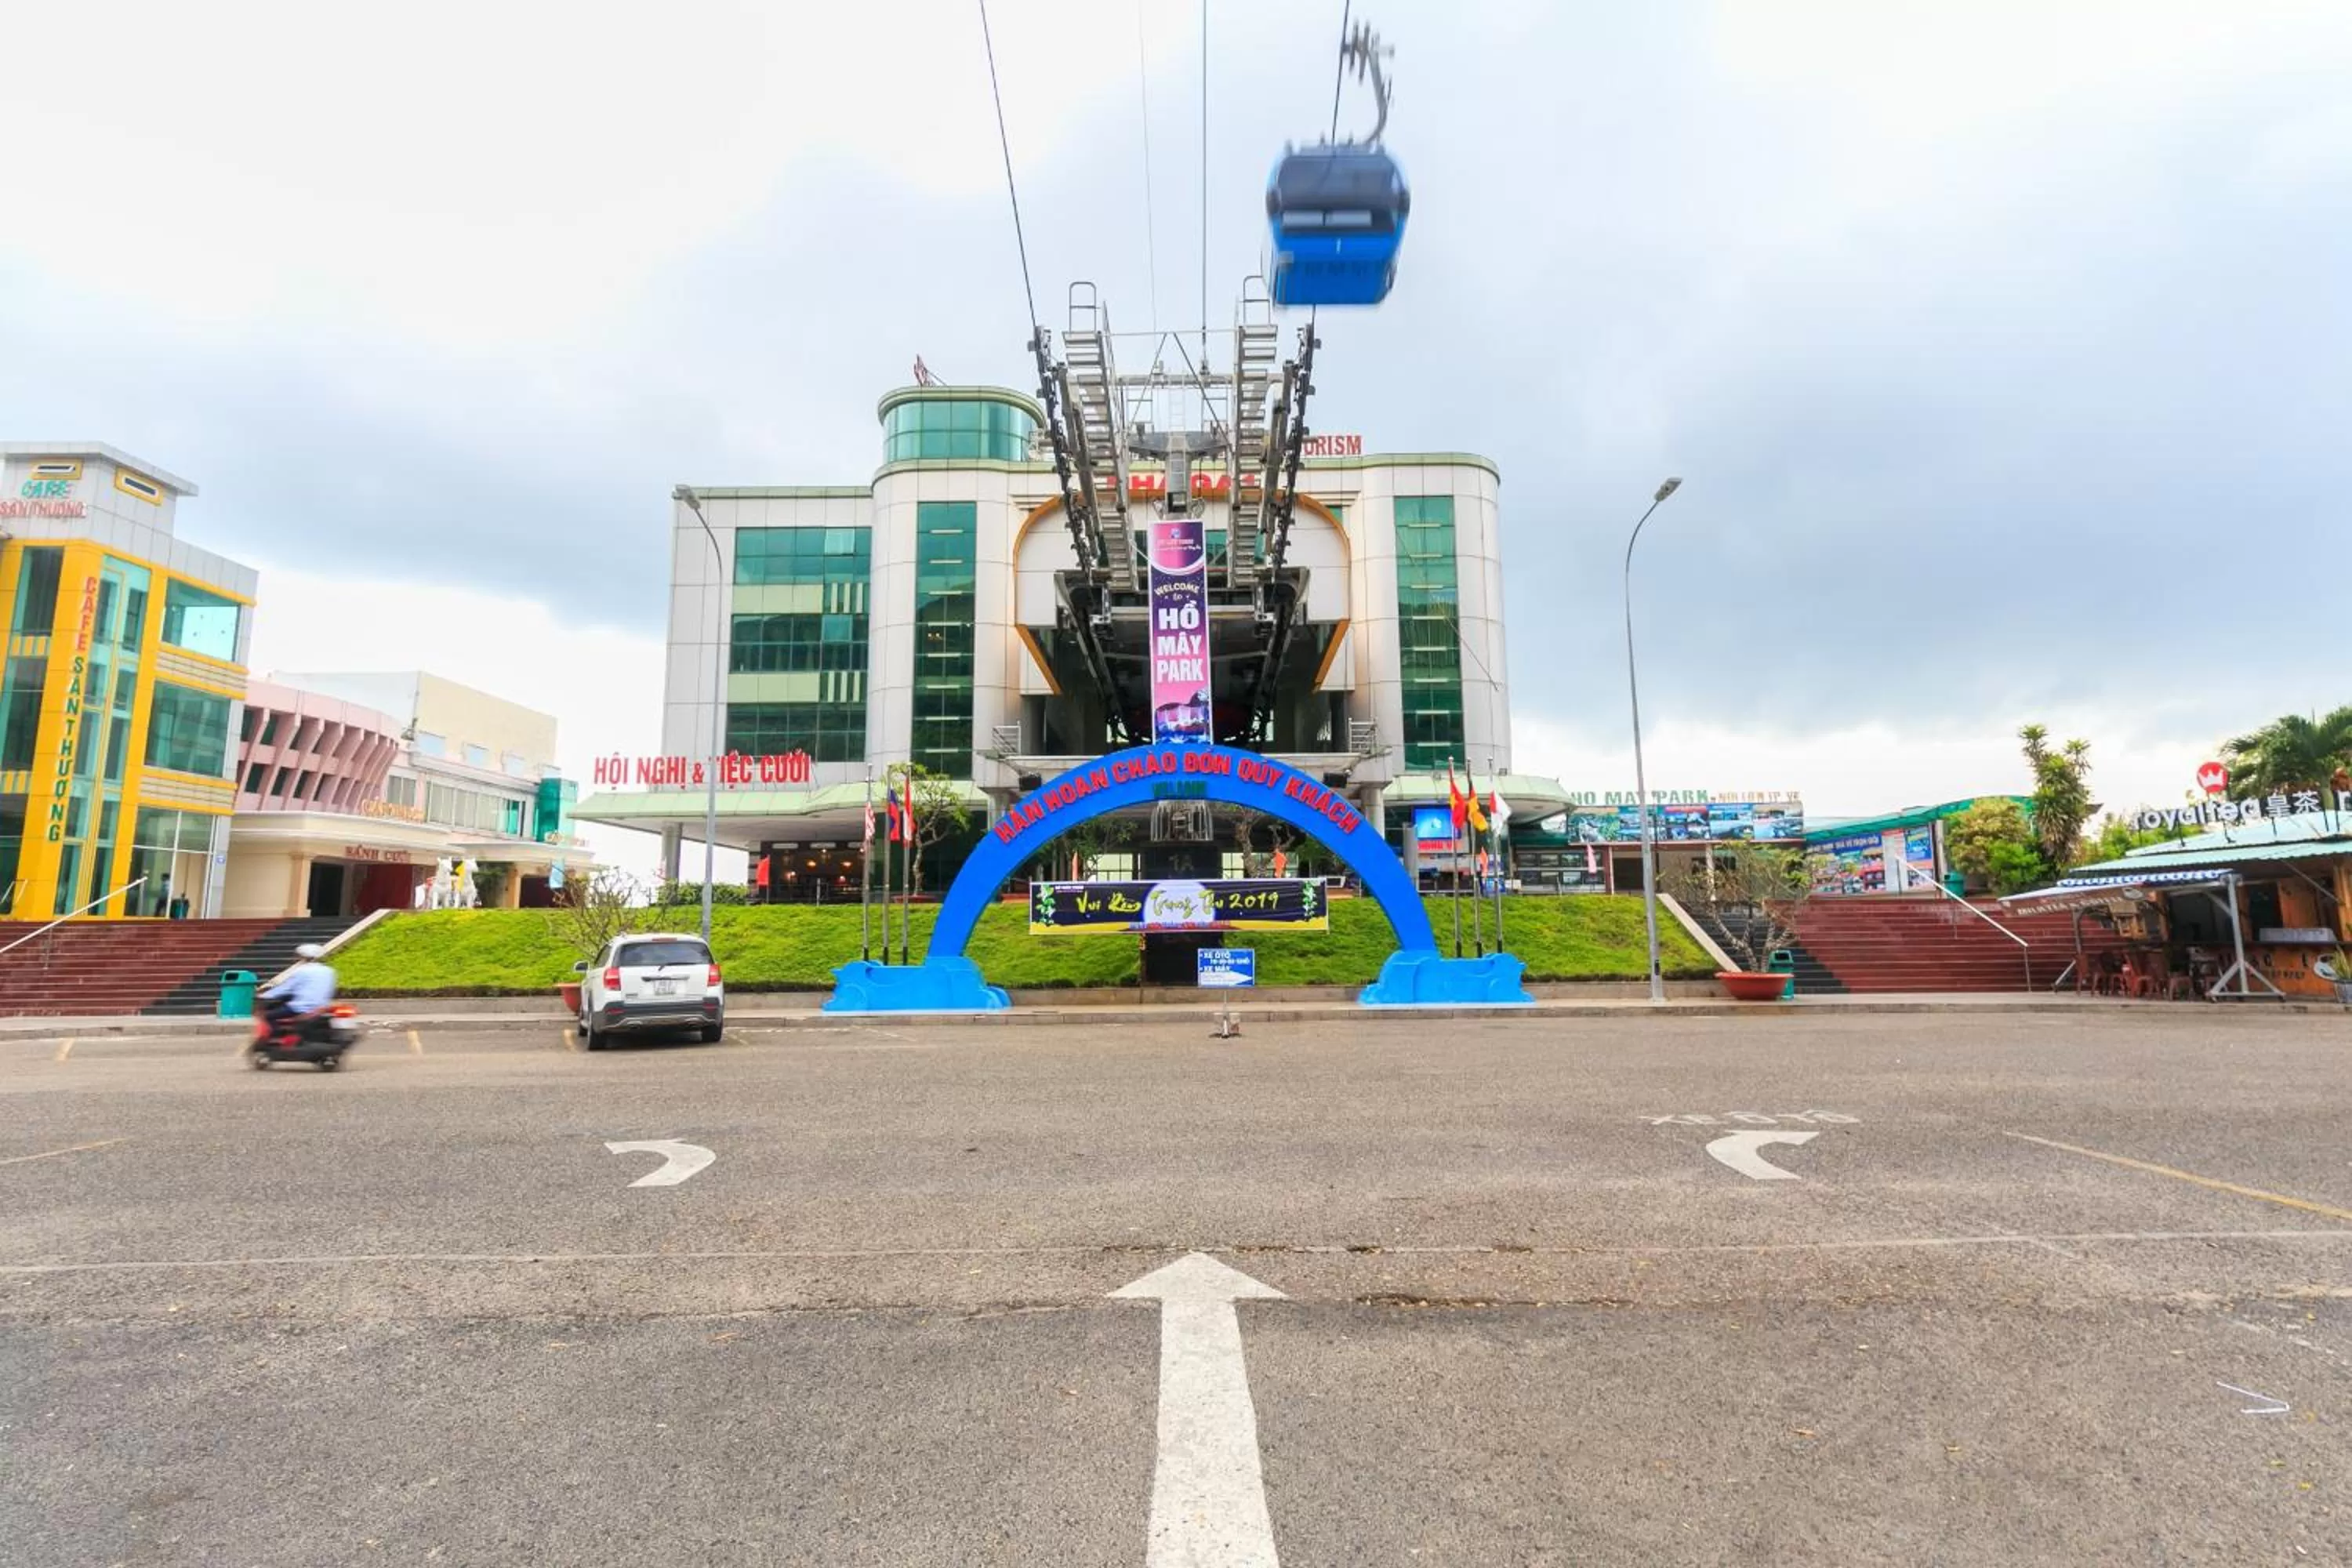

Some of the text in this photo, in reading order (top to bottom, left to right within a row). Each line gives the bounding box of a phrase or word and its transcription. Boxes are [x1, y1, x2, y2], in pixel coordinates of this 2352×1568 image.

[1303, 435, 1362, 455] URISM
[1154, 583, 1200, 596] WELCOME
[77, 576, 97, 652] CAFE
[1158, 600, 1200, 630] HỒ
[1157, 631, 1202, 656] MÂY
[1156, 659, 1204, 684] PARK
[593, 751, 628, 790] HỘI
[637, 755, 687, 790] NGHỊ
[692, 762, 705, 784] &
[760, 747, 811, 784] CƯỚI
[1042, 767, 1109, 813] HOAN
[1111, 750, 1177, 783] CHÀO
[1284, 775, 1360, 834] KHÁCH
[1656, 789, 1708, 804] PARK
[2267, 791, 2321, 818] 皇茶
[2130, 797, 2262, 831] royaltea
[1076, 890, 1102, 913] Vui
[1229, 891, 1279, 910] 2019
